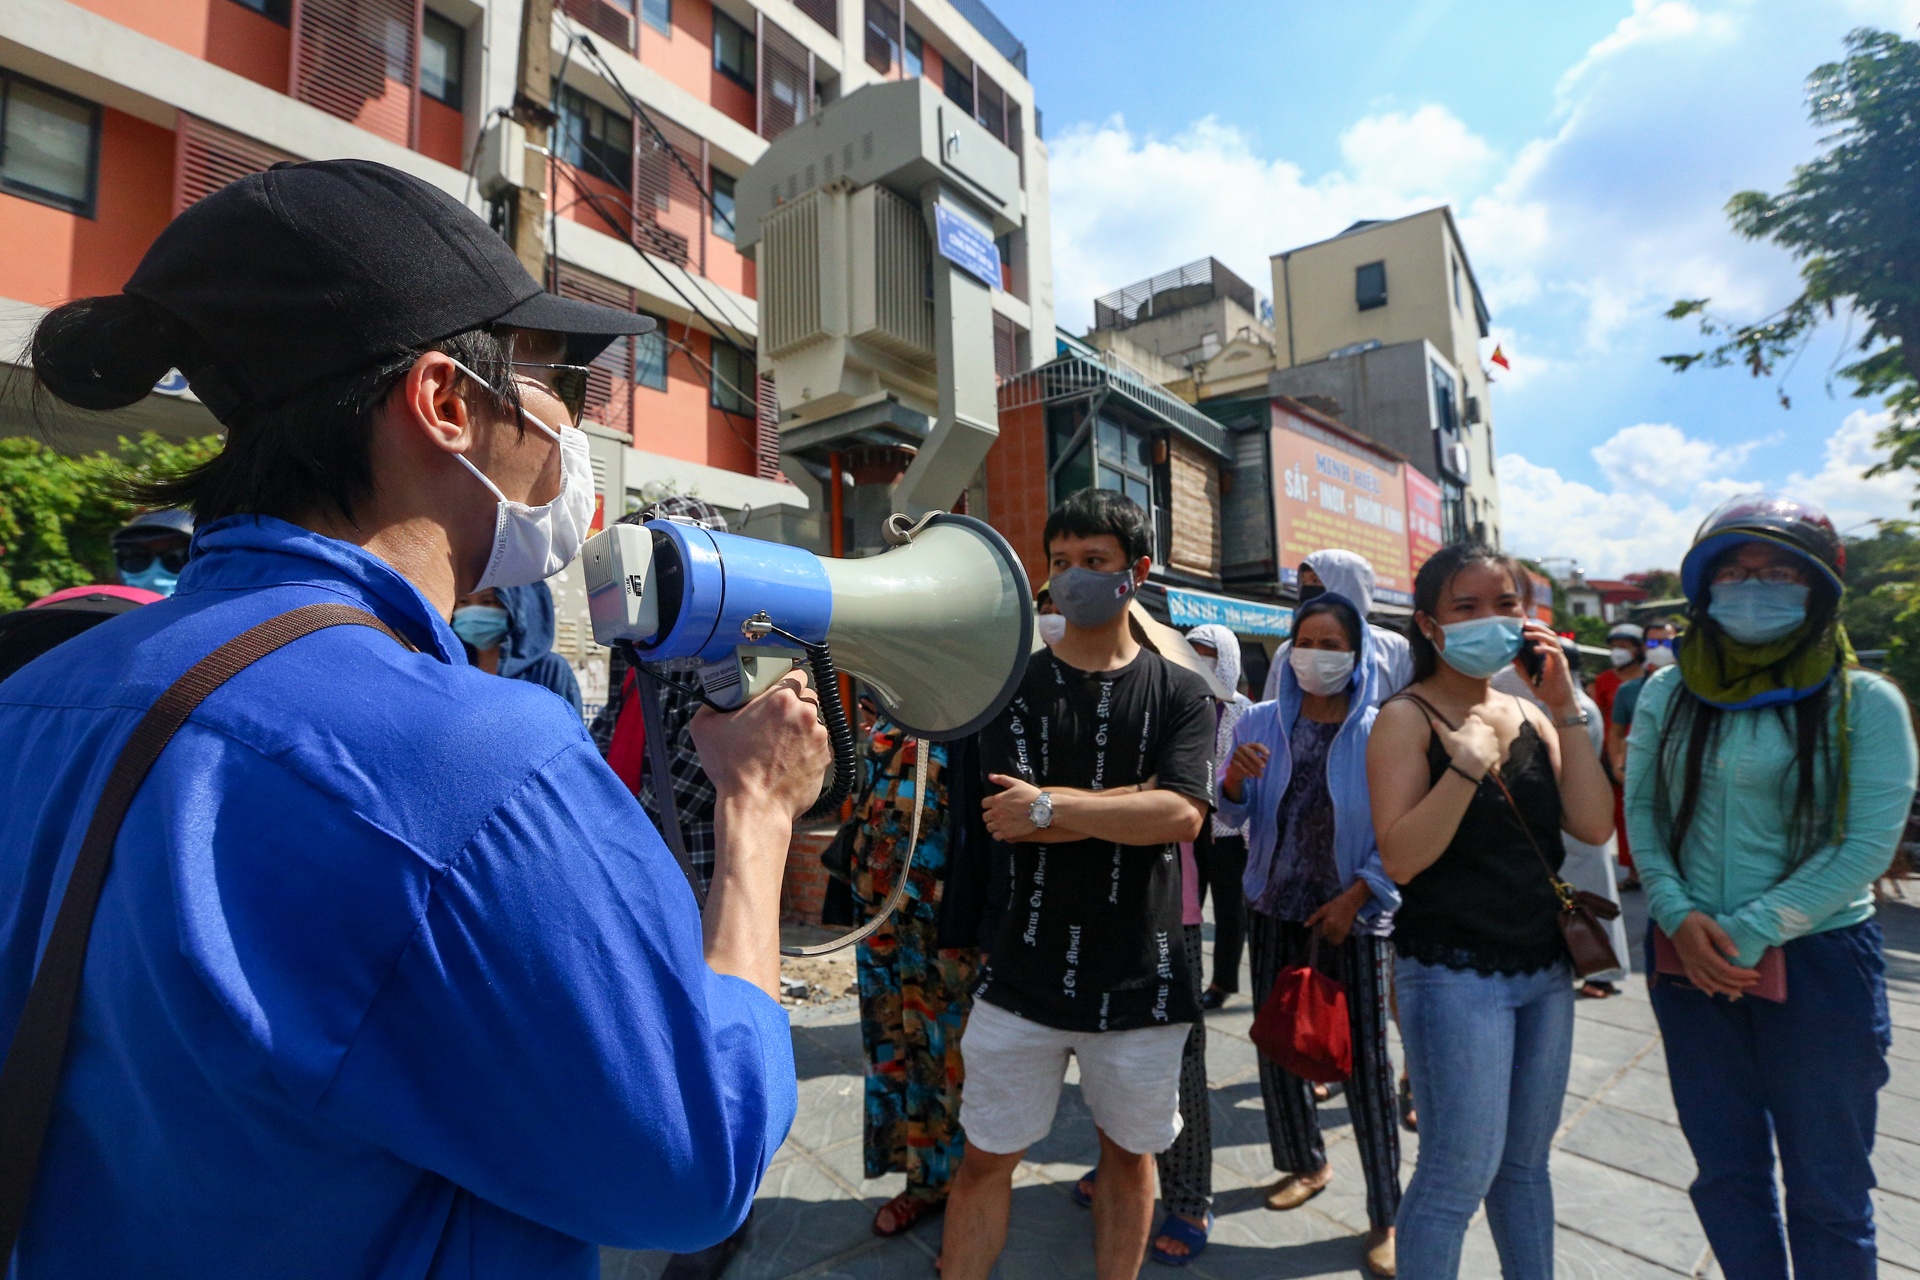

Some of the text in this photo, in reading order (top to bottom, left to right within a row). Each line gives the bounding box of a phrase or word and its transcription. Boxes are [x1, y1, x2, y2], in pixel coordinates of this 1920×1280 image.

[1316, 453, 1350, 483] MINH
[1095, 723, 1108, 746] On
[1016, 739, 1032, 775] Focus
[1029, 889, 1043, 908] On
[1023, 911, 1039, 947] Focus
[1066, 924, 1082, 966] Myself
[1156, 931, 1173, 979] Myself
[1063, 969, 1076, 987] On
